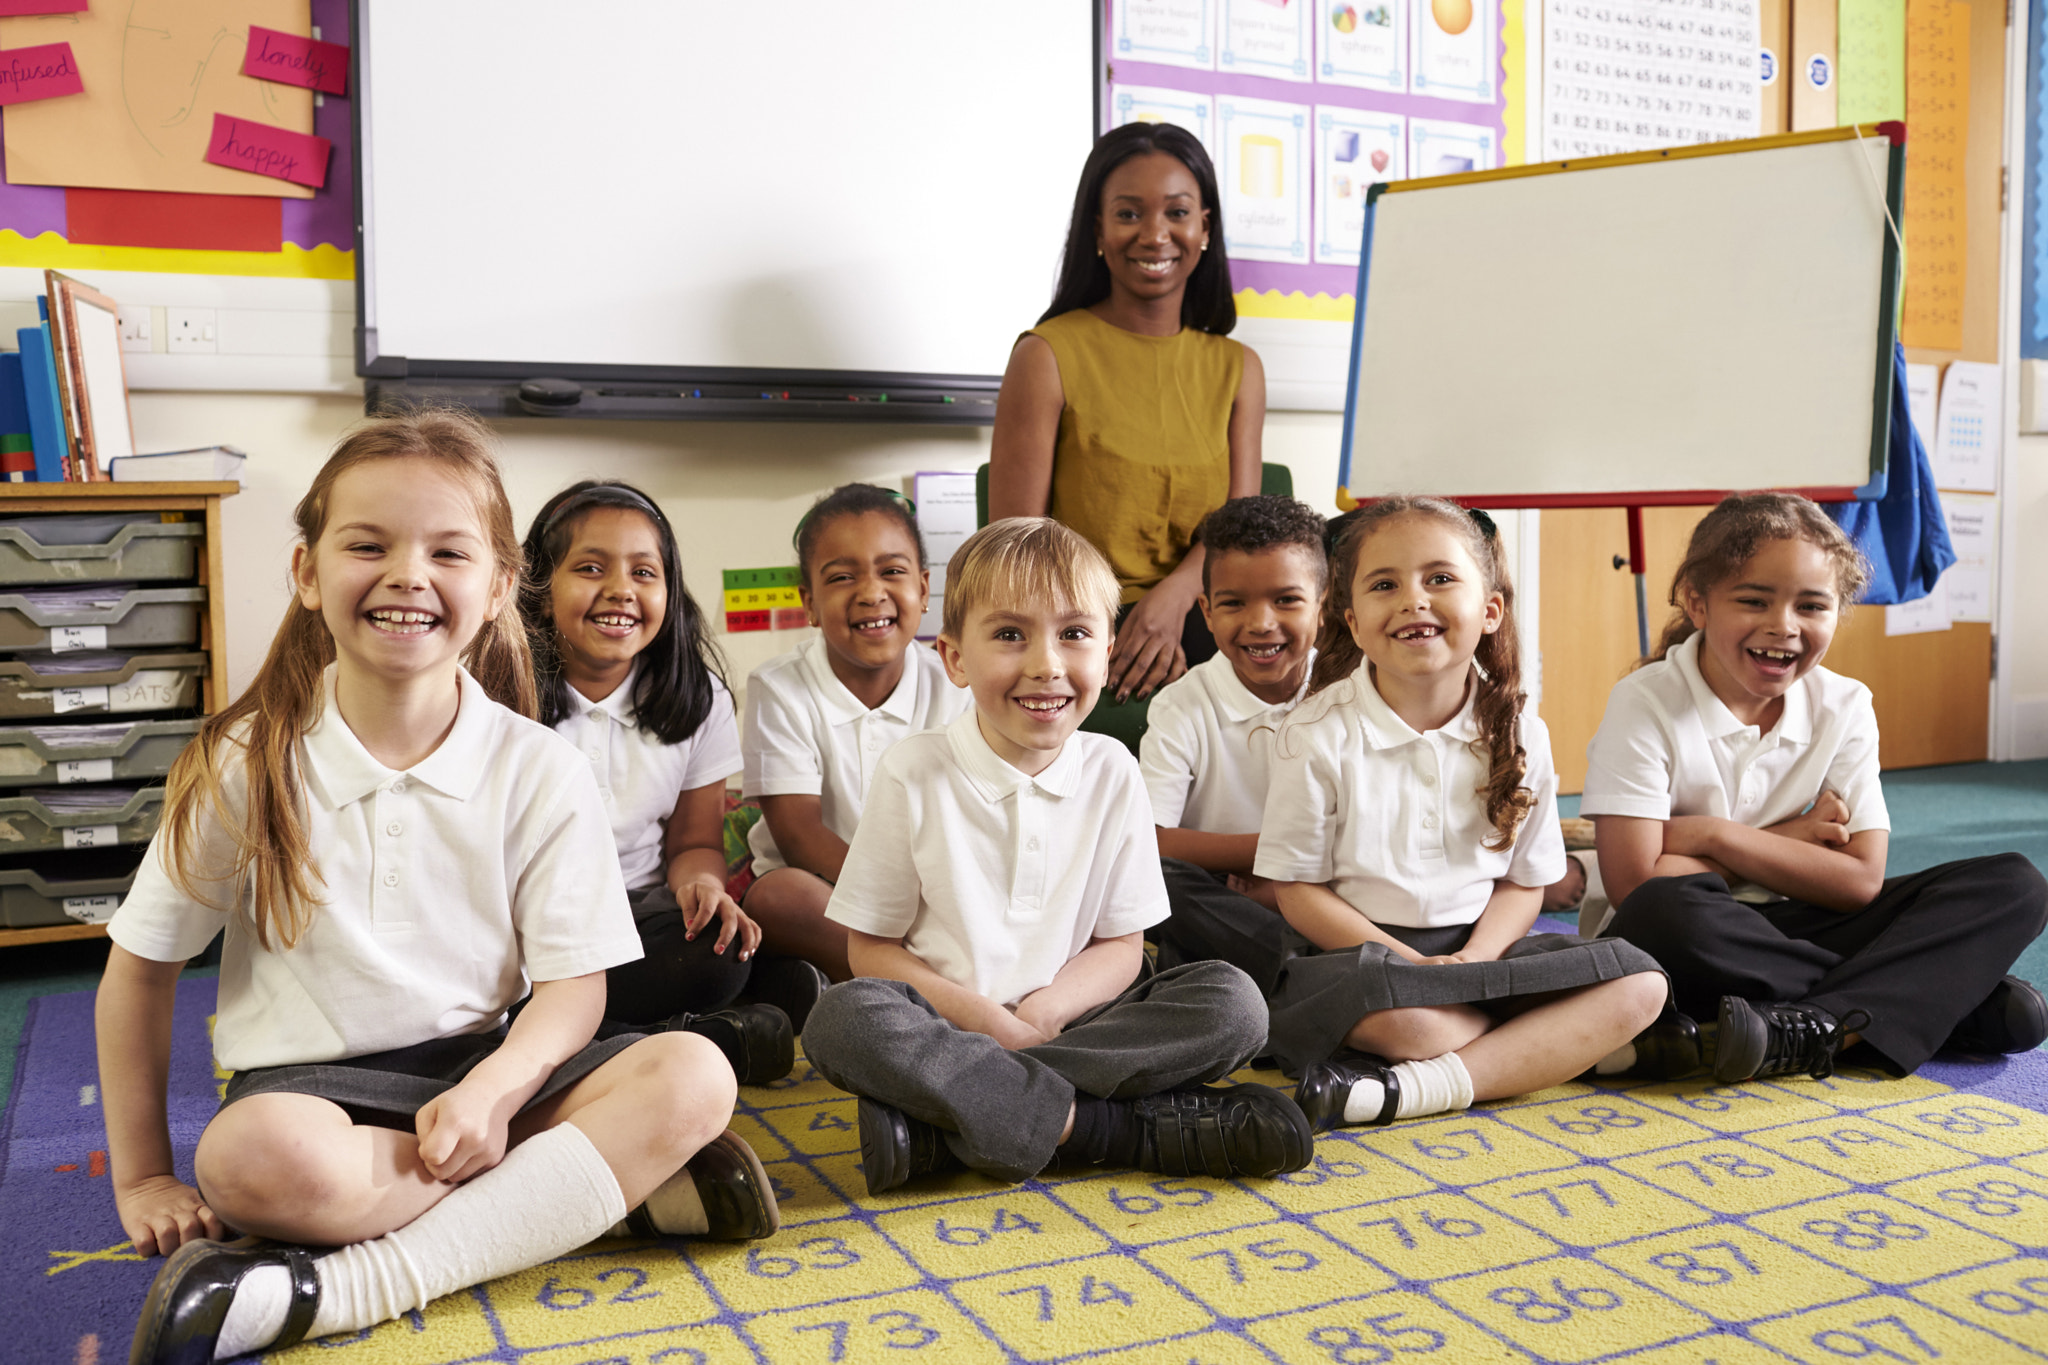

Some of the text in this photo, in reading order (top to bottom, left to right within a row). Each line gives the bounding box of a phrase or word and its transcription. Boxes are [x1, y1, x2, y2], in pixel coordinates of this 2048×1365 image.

[1554, 2, 1752, 43] 41 42 43 44 45 46 47 48 49 50
[1736, 3, 1752, 17] 40
[256, 36, 328, 86] lonely
[1553, 28, 1568, 43] 51
[1574, 32, 1590, 47] 52
[1594, 35, 1610, 50] 53
[1615, 38, 1631, 52] 54
[1635, 41, 1652, 56] 55
[1657, 44, 1673, 58] 56
[1677, 46, 1694, 59] 57
[1698, 49, 1714, 62] 58
[1719, 51, 1734, 65] 59
[1737, 56, 1752, 68] 60
[1553, 58, 1753, 95] 61 62 63 64 65 66 67 68 69 70
[1553, 84, 1751, 121] 71 72 73 74 75 76 77 78 79 80
[1552, 112, 1566, 125] 81
[1573, 115, 1590, 129] 82
[1594, 118, 1609, 131] 83
[1615, 121, 1630, 133] 84
[1635, 123, 1650, 136] 85
[1656, 125, 1671, 138] 86
[1676, 127, 1691, 140] 87
[220, 122, 298, 180] happy
[1238, 212, 1287, 229] cylinder
[732, 592, 794, 603] 10 20 30 40
[1673, 1086, 1773, 1112] 69
[1547, 1107, 1647, 1135] 68
[1915, 1106, 2021, 1135] 80
[1410, 1129, 1494, 1161] 67
[1786, 1129, 1912, 1159] 79
[1656, 1153, 1775, 1187] 78
[1109, 1179, 1216, 1215] 65
[1511, 1179, 1619, 1218] 77
[1937, 1180, 2048, 1217] 89
[935, 1208, 1044, 1247] 64
[1358, 1209, 1485, 1250] 76
[1801, 1209, 1930, 1251] 88
[746, 1237, 861, 1279] 63
[1190, 1238, 1322, 1285] 75
[1648, 1240, 1763, 1286] 87
[536, 1266, 662, 1311] 62
[999, 1275, 1136, 1322] 74
[1487, 1277, 1622, 1324] 86
[794, 1310, 941, 1363] 73
[1306, 1311, 1447, 1365] 85
[1811, 1315, 1941, 1365] 97
